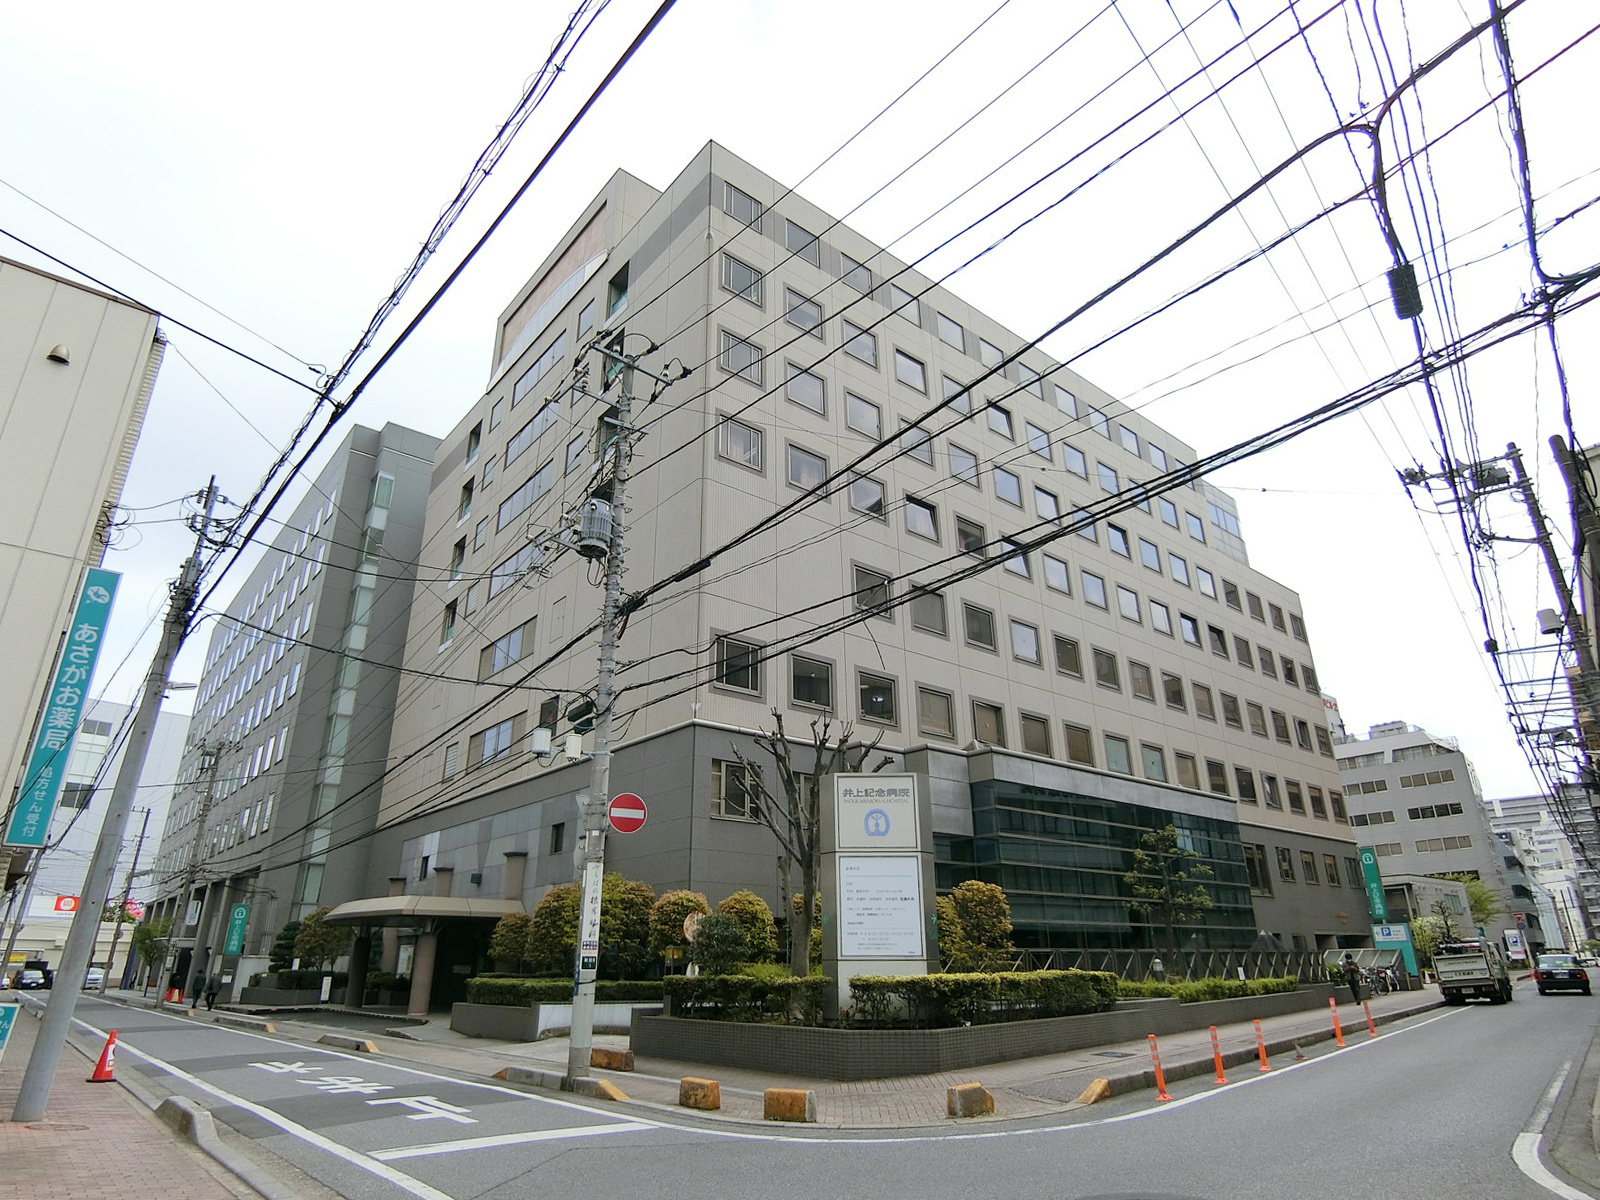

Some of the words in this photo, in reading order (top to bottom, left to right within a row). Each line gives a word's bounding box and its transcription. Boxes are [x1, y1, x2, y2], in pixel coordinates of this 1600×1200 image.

[40, 622, 99, 751] あさがお薬局
[22, 765, 54, 838] 処方せん受付
[842, 787, 910, 798] 井上記念病院
[247, 1061, 479, 1124] 止まれ
